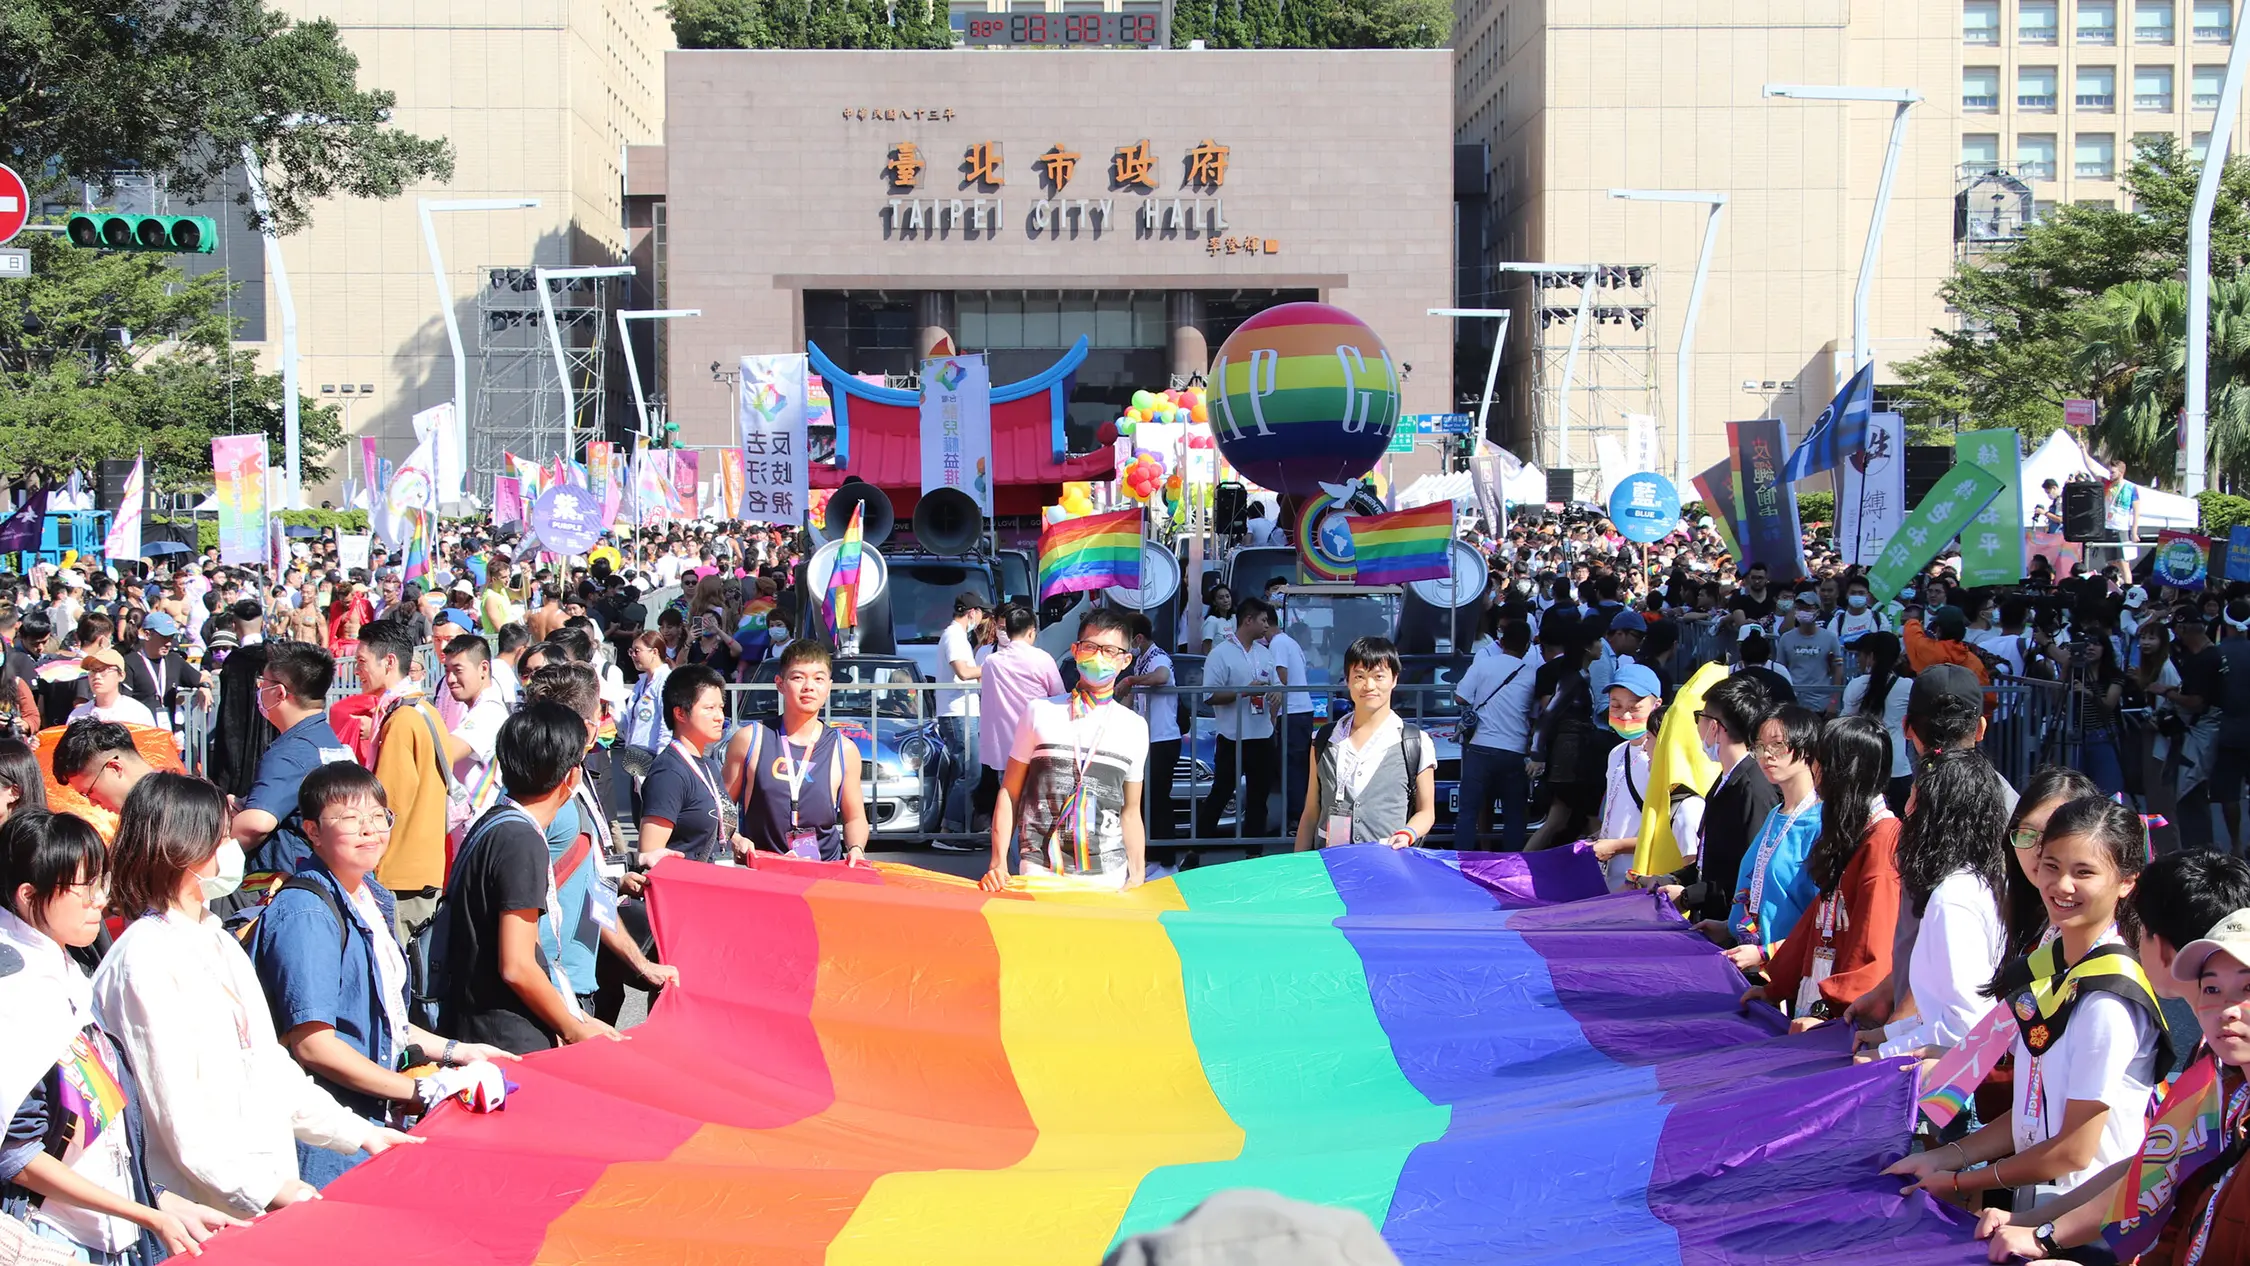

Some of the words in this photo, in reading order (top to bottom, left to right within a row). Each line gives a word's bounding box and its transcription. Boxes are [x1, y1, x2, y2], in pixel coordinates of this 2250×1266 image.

[887, 138, 1230, 191] 臺北市政府
[889, 199, 1003, 229] TAIPEI
[1035, 199, 1114, 229] CITY
[1145, 199, 1230, 229] HALL
[552, 520, 583, 532] PURPLE
[1634, 509, 1655, 519] BLUE
[1751, 877, 1764, 912] TAIWAN
[2226, 923, 2243, 931] NYC
[2028, 1091, 2039, 1117] AGE
